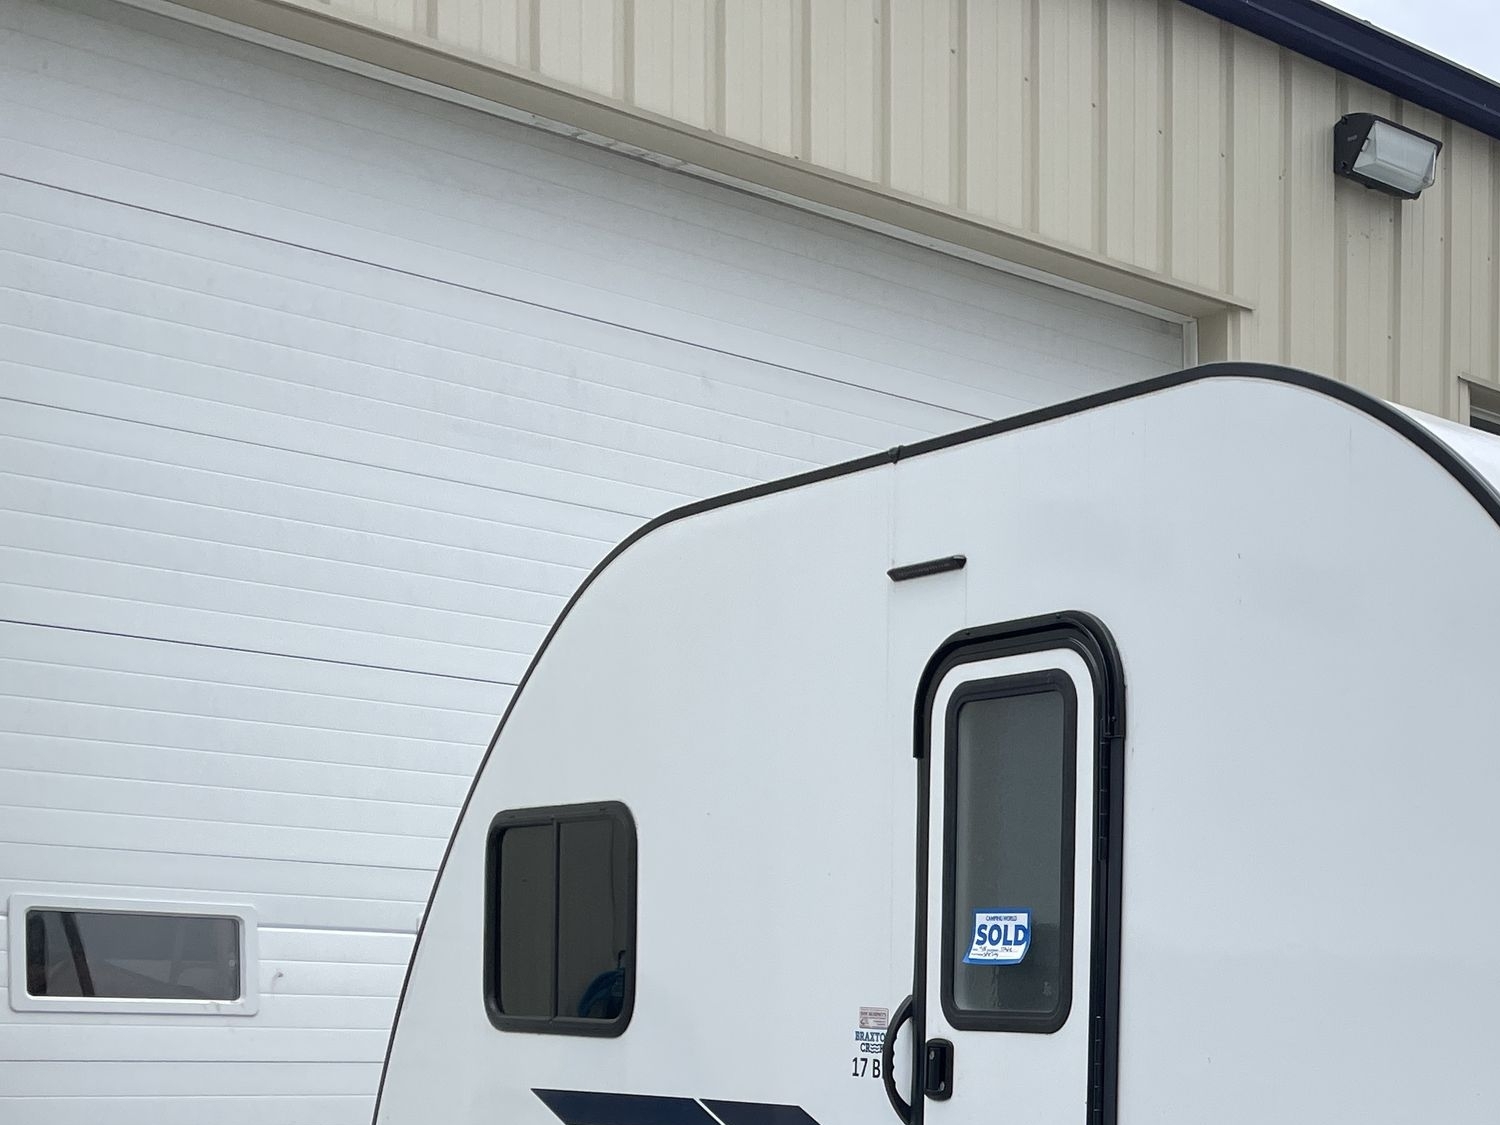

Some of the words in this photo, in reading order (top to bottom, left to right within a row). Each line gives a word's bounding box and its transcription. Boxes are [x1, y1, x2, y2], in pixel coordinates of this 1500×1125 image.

[975, 923, 1030, 946] SOLD
[855, 1031, 886, 1042] BRAXTO
[852, 1057, 868, 1077] 17
